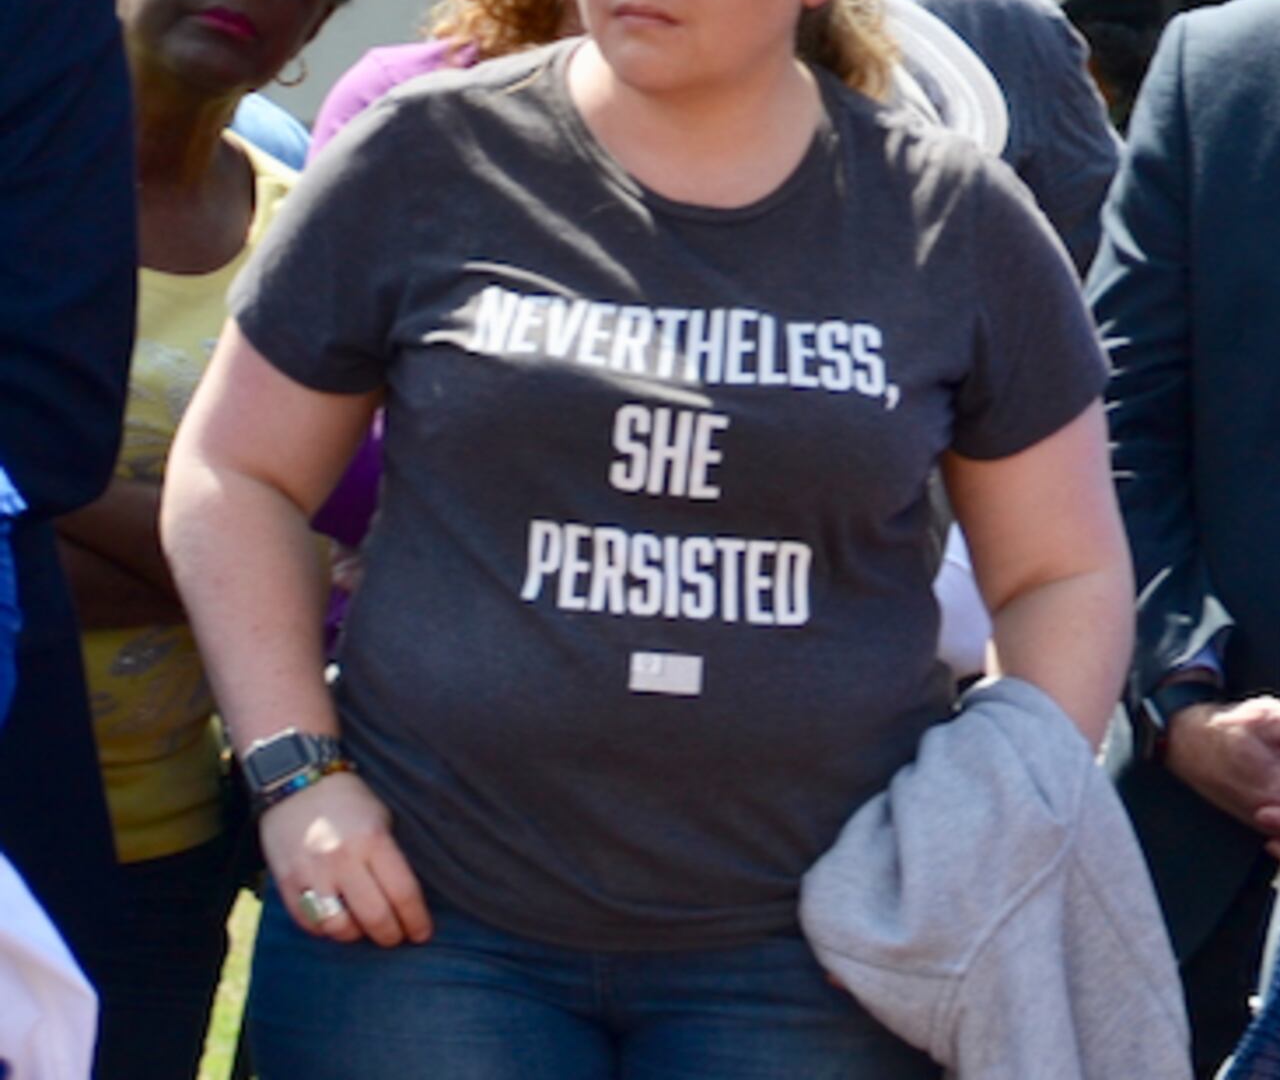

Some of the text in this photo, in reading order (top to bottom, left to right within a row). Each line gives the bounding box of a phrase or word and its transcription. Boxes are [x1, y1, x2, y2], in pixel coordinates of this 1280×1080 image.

[470, 286, 900, 410] NEVERTHELESS,
[609, 404, 729, 500] SHE
[520, 519, 812, 626] PERSISTED
